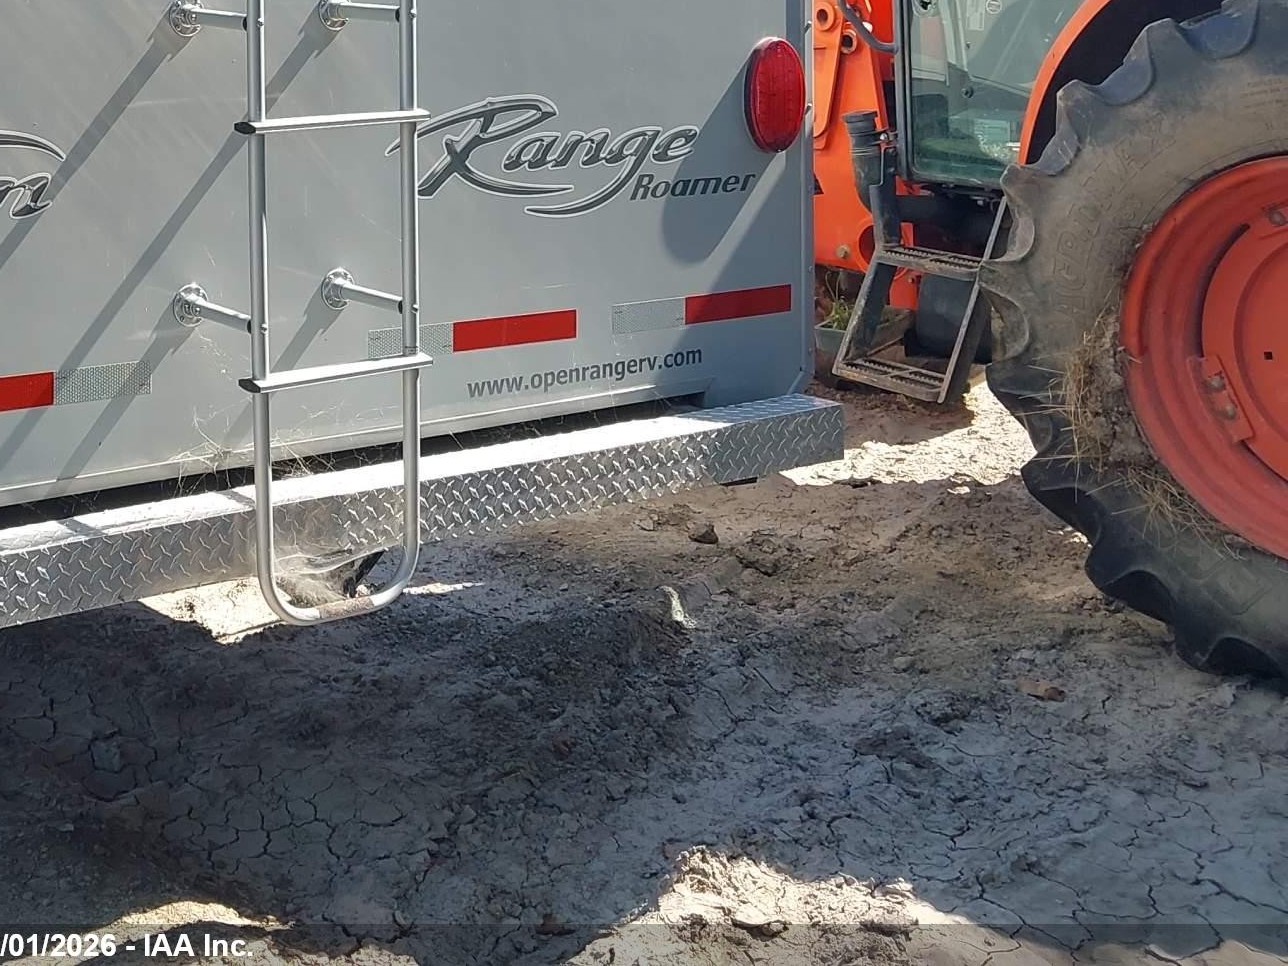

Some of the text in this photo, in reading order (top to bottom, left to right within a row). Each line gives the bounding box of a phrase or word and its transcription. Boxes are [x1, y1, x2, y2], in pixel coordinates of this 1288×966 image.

[386, 94, 700, 218] Range
[630, 172, 756, 201] Roamer
[467, 346, 703, 399] www.openrangerv.com
